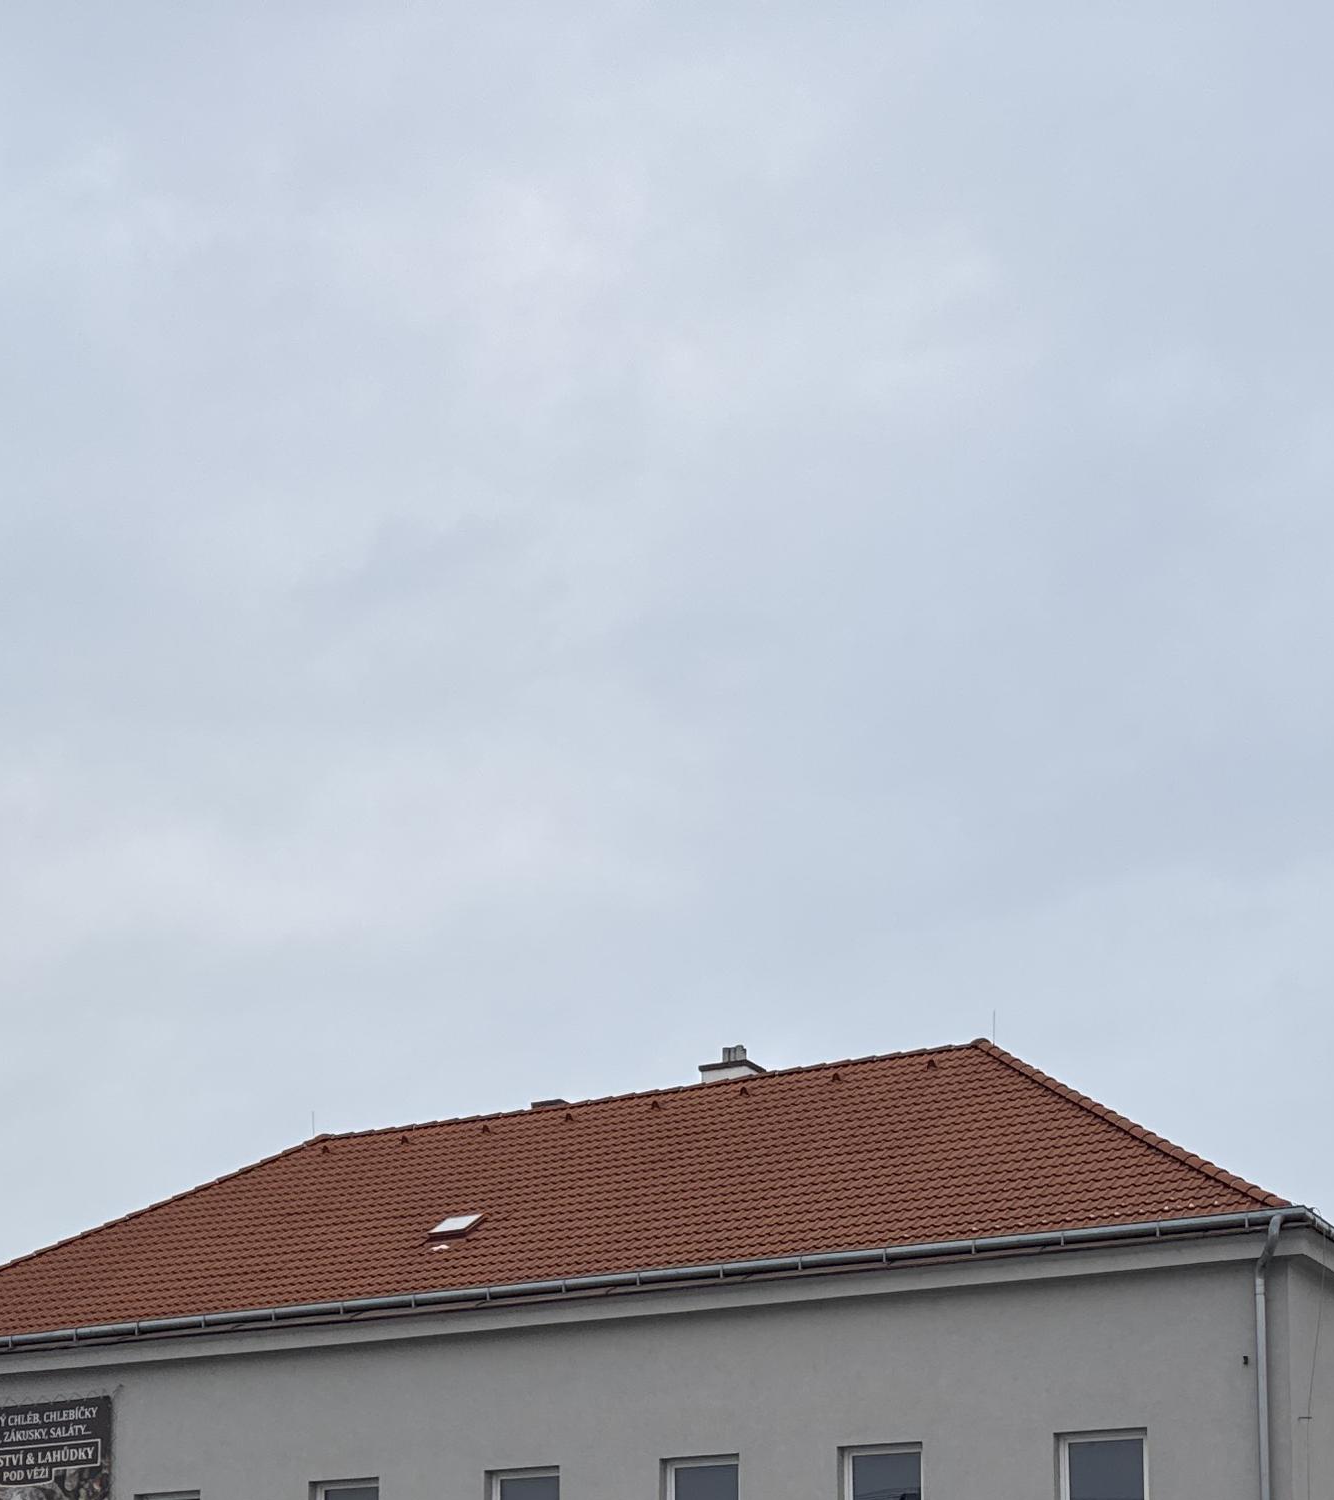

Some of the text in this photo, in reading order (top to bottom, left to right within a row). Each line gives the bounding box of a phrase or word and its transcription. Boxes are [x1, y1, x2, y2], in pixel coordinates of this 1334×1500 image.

[8, 1410, 42, 1426] CHLÉB,
[43, 1406, 98, 1423] CHLEBÍČKY
[25, 1452, 35, 1466] &
[37, 1444, 95, 1464] LAHŮDKY
[2, 1466, 49, 1482] POD VĚŽÍ
